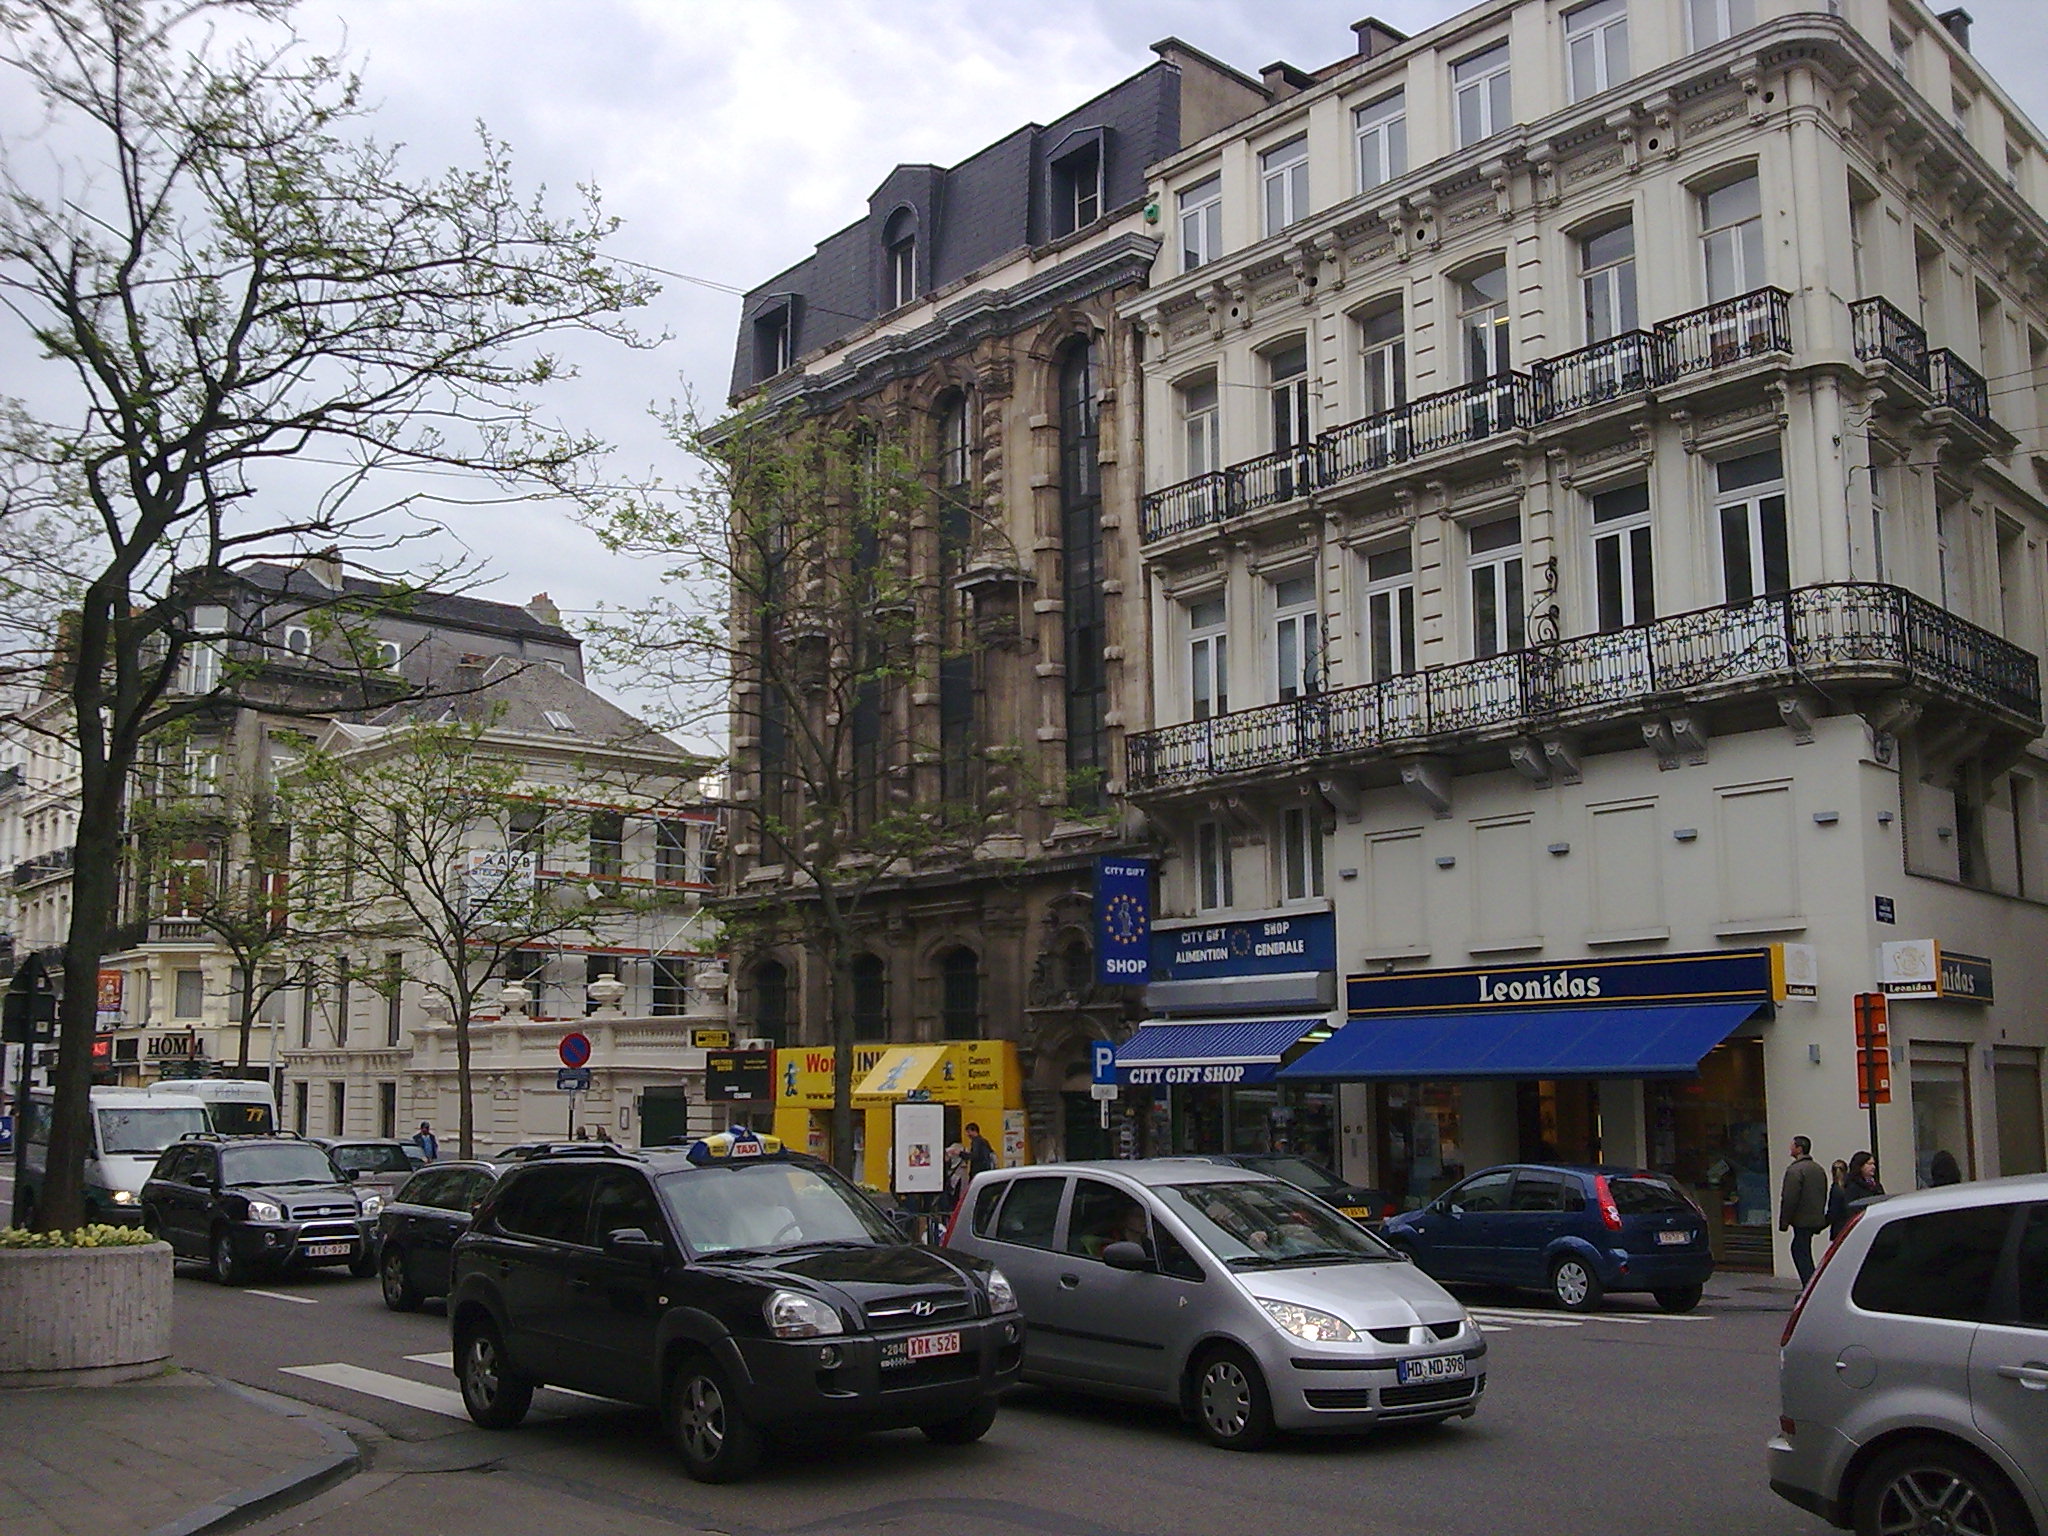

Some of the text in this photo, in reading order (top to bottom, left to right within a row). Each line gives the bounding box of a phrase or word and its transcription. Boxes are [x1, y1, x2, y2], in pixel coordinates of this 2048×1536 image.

[1105, 866, 1124, 875] CITY
[1181, 928, 1227, 944] CITY GIFT
[1263, 921, 1290, 936] SHOP
[1255, 940, 1305, 956] GENERALE
[1106, 958, 1147, 973] SHOP
[1478, 970, 1600, 1002] Leonidas
[1942, 964, 1976, 994] nidas
[1889, 981, 1933, 993] Leonidas
[806, 1053, 837, 1073] Wor
[968, 1056, 992, 1065] Canon
[1096, 1047, 1113, 1078] P
[968, 1069, 990, 1079] Epson
[1129, 1066, 1245, 1084] CITY GIFT SHOP
[246, 1107, 264, 1122] 77
[736, 1144, 758, 1154] TAXI
